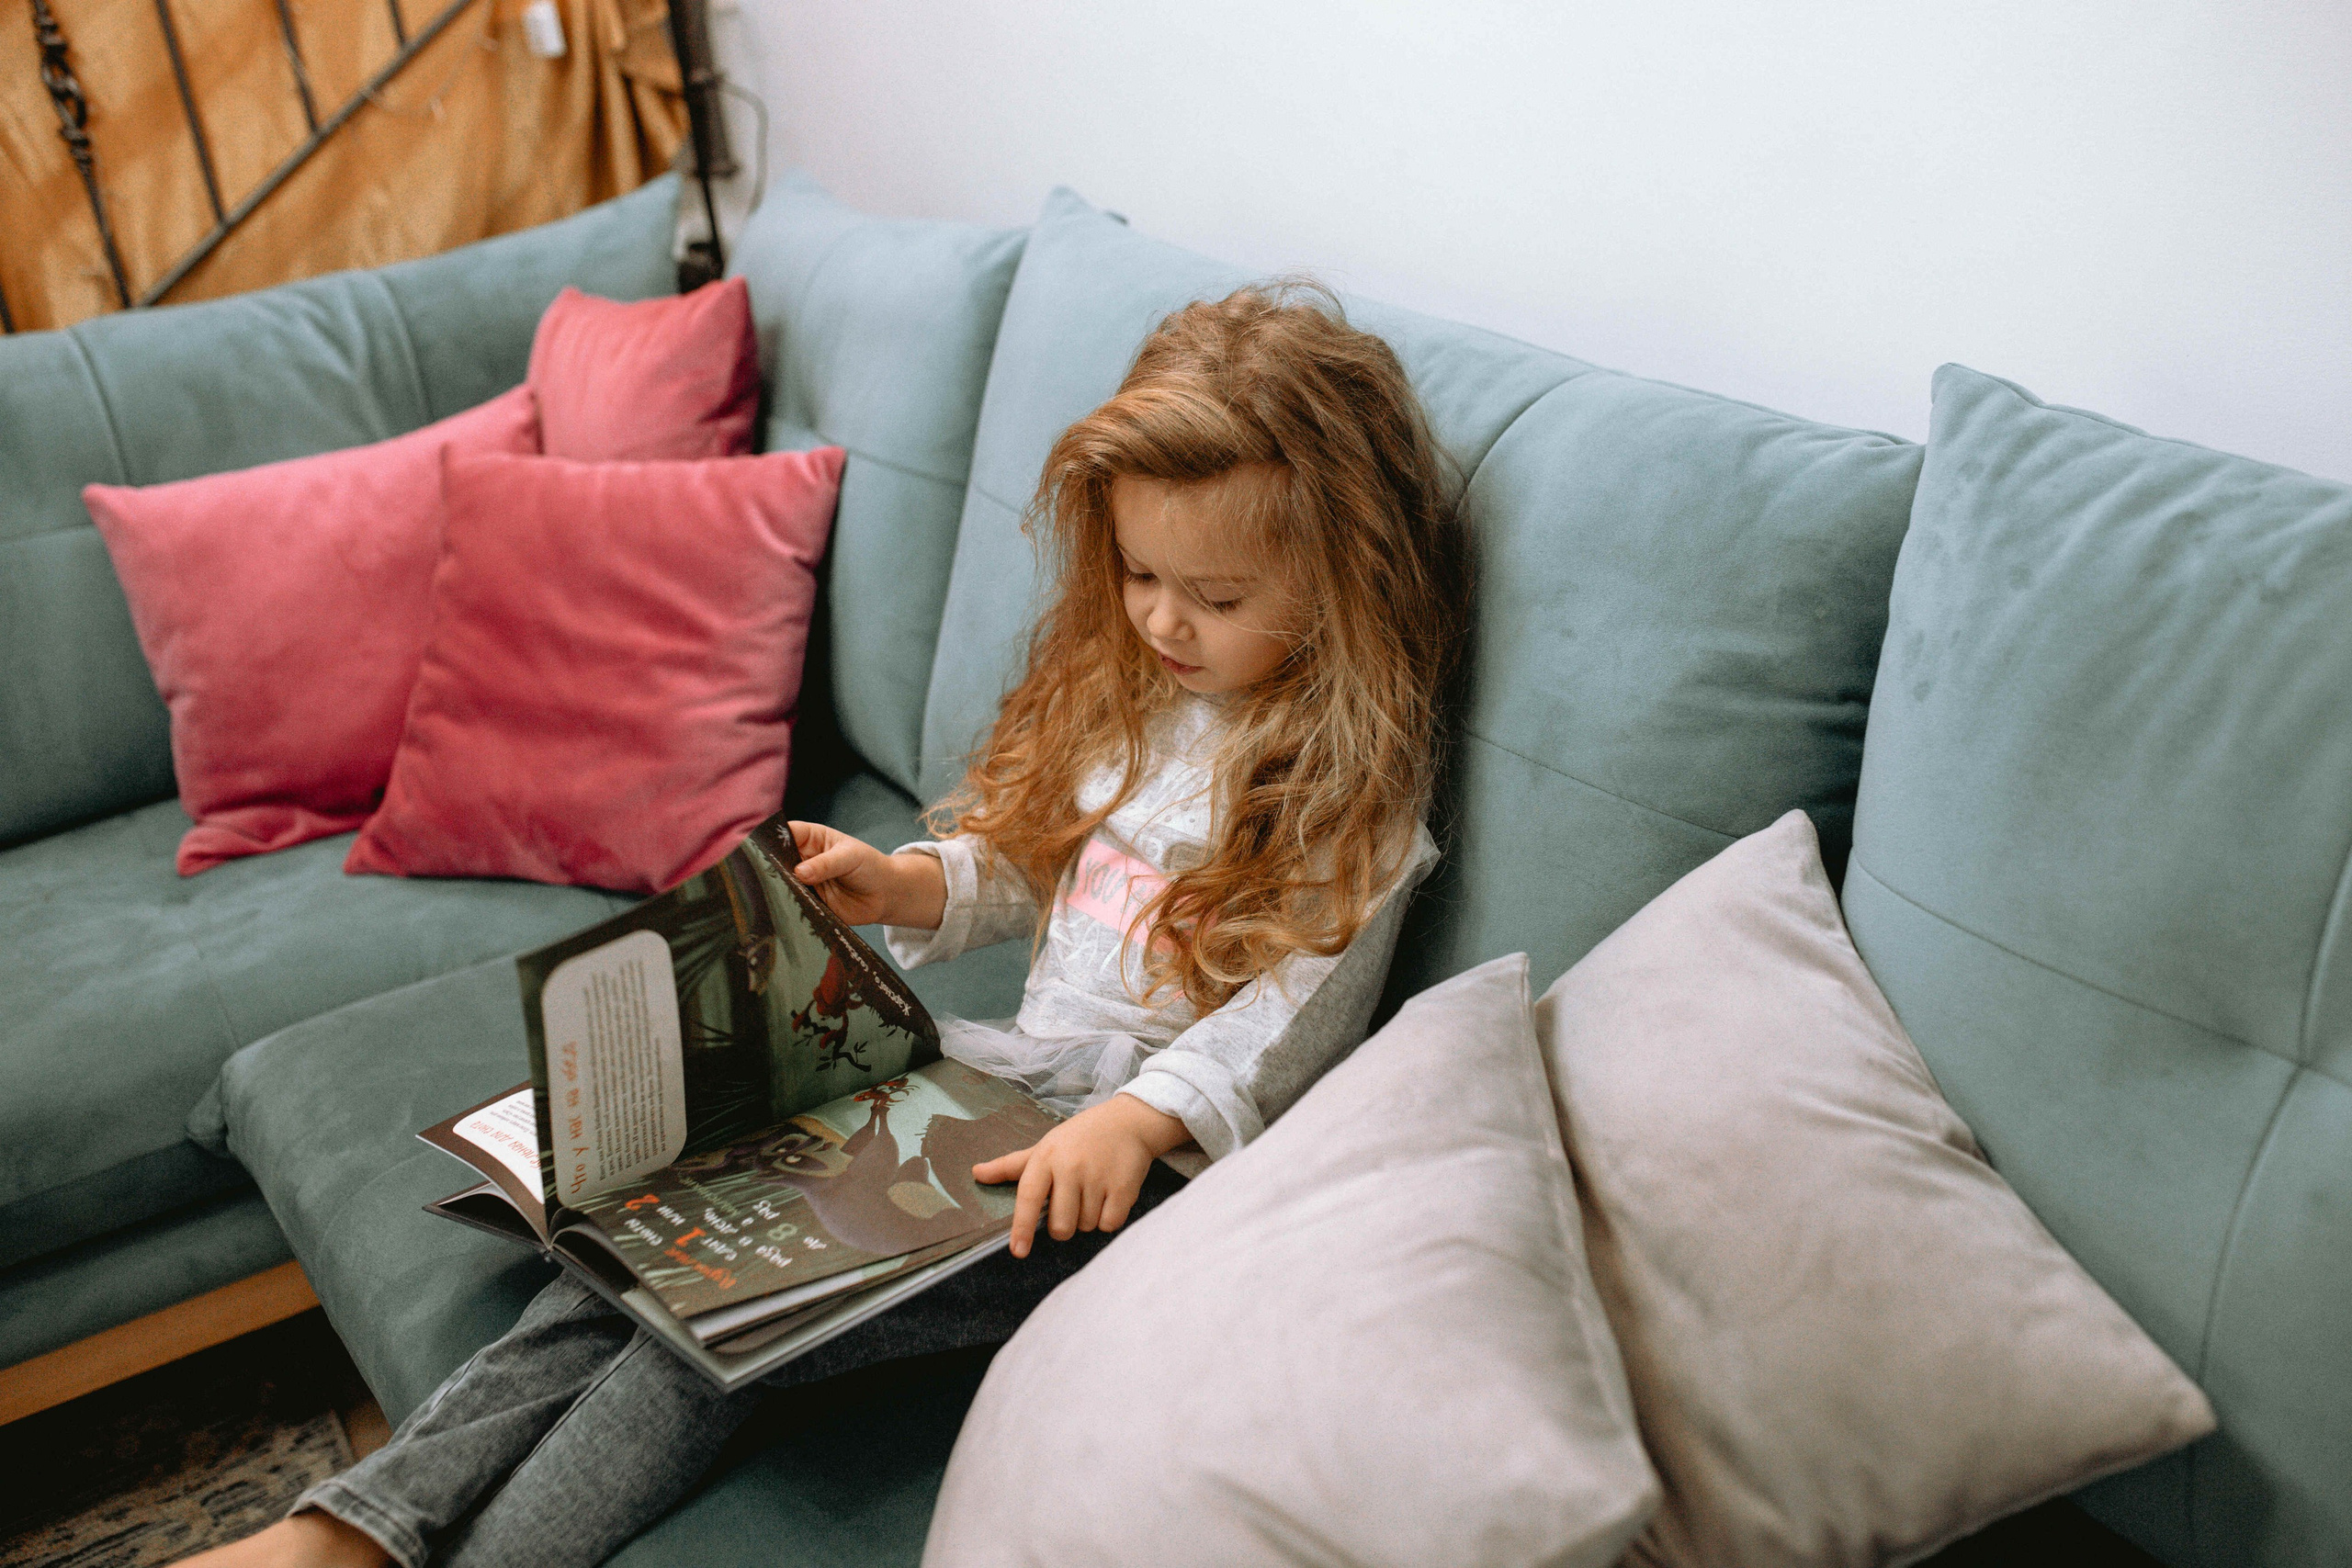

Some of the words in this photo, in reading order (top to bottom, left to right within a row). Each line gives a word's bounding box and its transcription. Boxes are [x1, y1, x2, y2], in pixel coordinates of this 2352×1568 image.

[1084, 857, 1125, 905] YOU
[568, 1114, 583, 1140] нас
[571, 1146, 591, 1156] у
[571, 1163, 588, 1194] Что
[625, 1193, 661, 1211] 2
[656, 1205, 686, 1226] или
[675, 1226, 707, 1247] 1
[767, 1223, 798, 1241] 8
